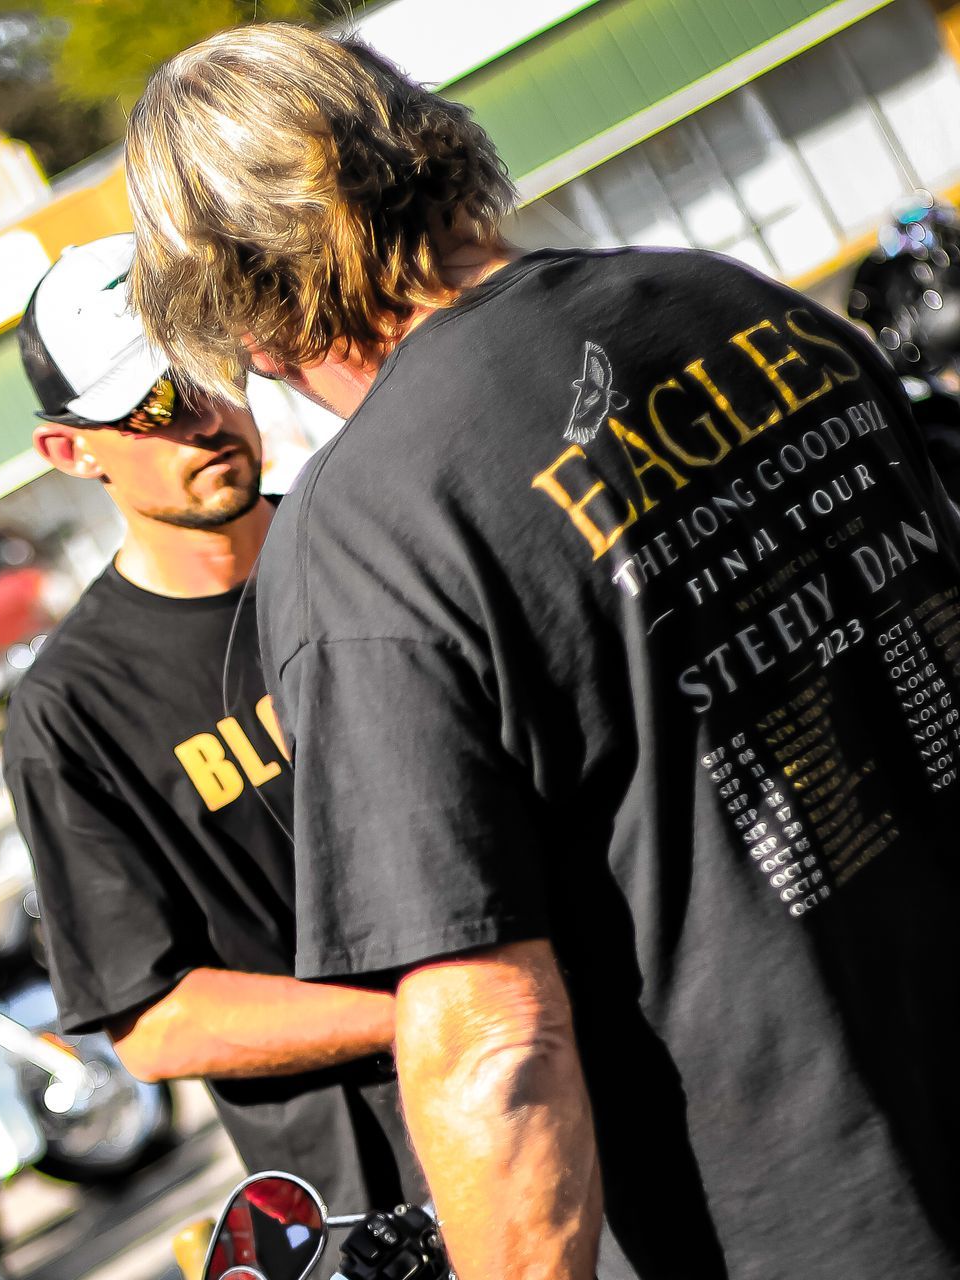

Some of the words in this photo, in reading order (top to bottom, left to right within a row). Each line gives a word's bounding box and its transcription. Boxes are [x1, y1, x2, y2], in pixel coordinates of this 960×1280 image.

[531, 309, 860, 561] EAGLES
[612, 532, 678, 596] THE
[676, 479, 756, 548] LONG
[687, 528, 779, 605] FINAL
[785, 464, 876, 530] TOUR
[678, 573, 834, 713] STEELY
[851, 510, 938, 593] DAN
[878, 623, 903, 646] OCT
[884, 639, 910, 663] OCT
[891, 655, 917, 679] OCT
[896, 670, 925, 695] NOV
[925, 662, 938, 677] 02
[902, 686, 931, 709] NOV
[932, 678, 946, 693] 04
[908, 702, 938, 728] NOV
[941, 692, 952, 708] 07
[914, 719, 944, 744] NOV
[173, 693, 291, 812] BL
[702, 747, 725, 768] SEP
[920, 735, 948, 760] NOV
[712, 763, 732, 783] SEP
[926, 754, 954, 776] NOV
[720, 778, 740, 798] SEP
[932, 769, 957, 792] NOV
[727, 794, 748, 813] SEP
[760, 778, 775, 793] 13
[735, 809, 757, 829] SEP
[744, 822, 767, 843] SEP
[750, 836, 777, 860] SEP
[761, 847, 792, 873] OCT
[770, 862, 802, 888] OCT
[780, 878, 811, 902] OCT
[789, 893, 818, 917] OCT
